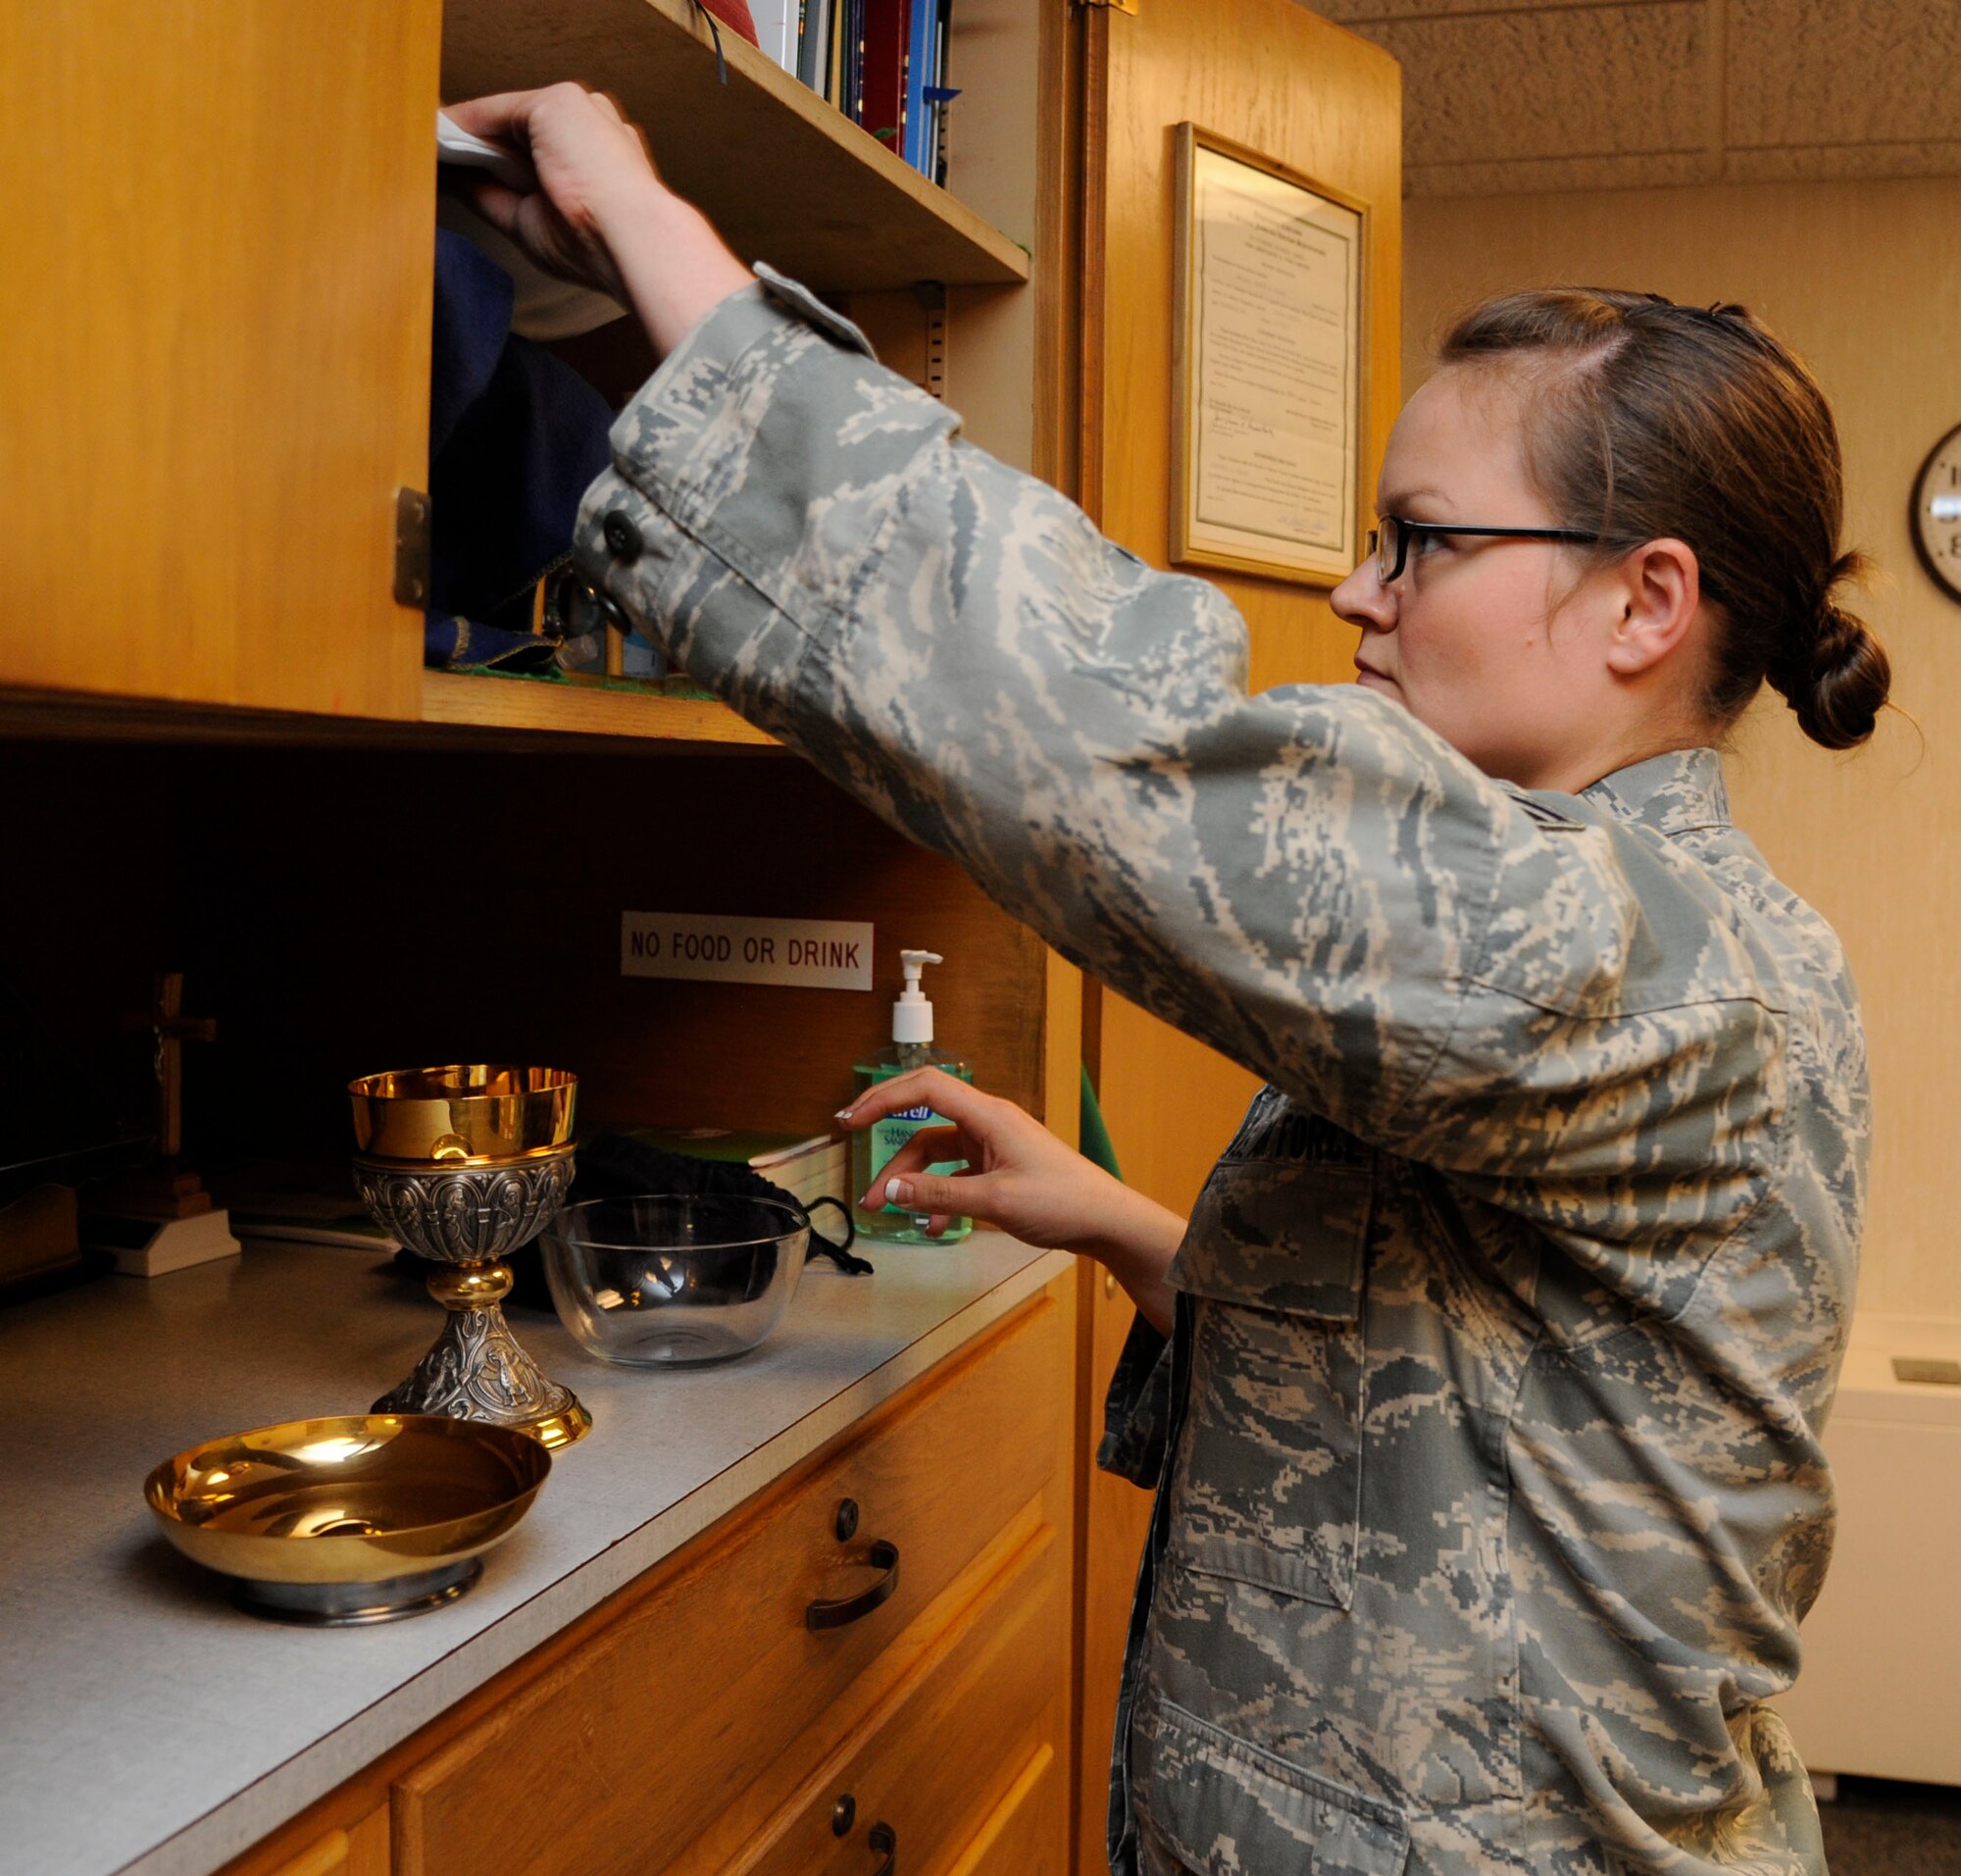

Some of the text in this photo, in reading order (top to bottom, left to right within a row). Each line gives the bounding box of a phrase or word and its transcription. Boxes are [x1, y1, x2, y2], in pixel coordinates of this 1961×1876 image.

[631, 931, 860, 969] NO FOOD OR DRINK
